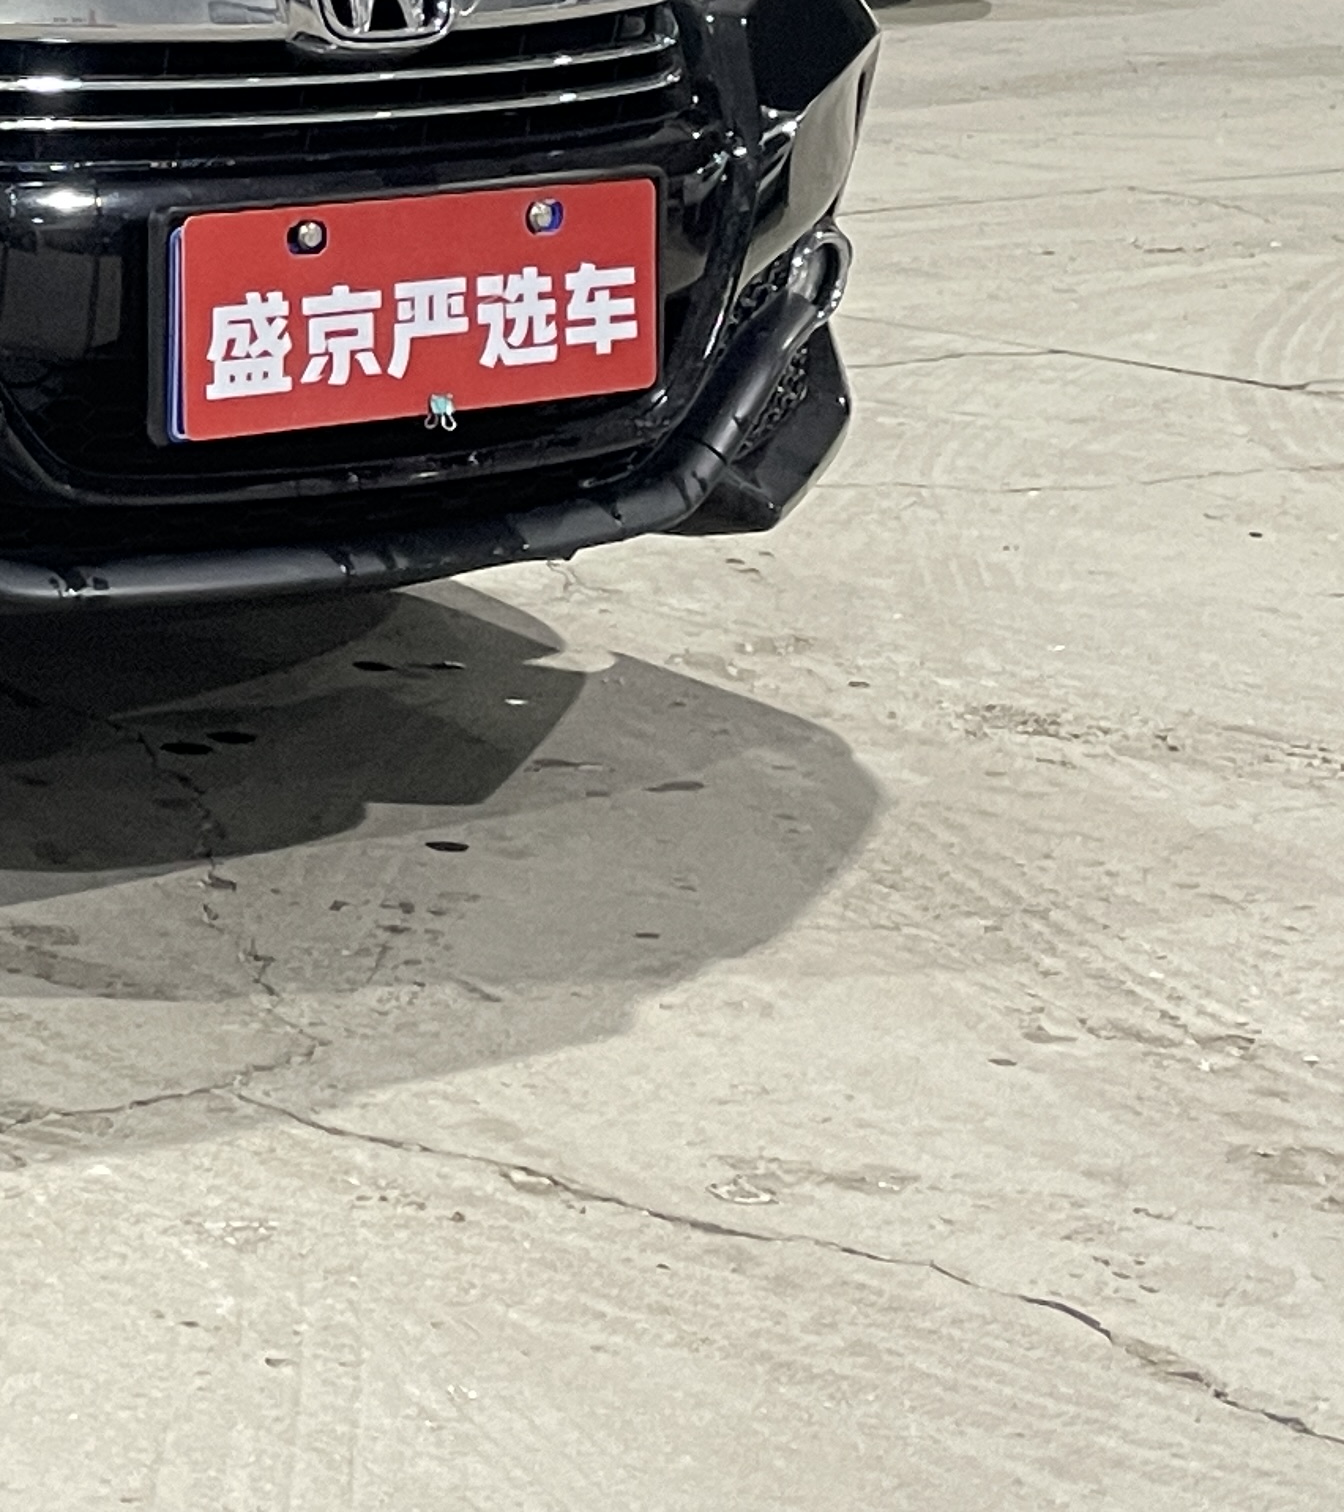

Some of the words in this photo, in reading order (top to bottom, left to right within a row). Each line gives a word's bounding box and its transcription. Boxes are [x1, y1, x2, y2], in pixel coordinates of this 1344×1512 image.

[205, 261, 639, 400] 盛京严选车
